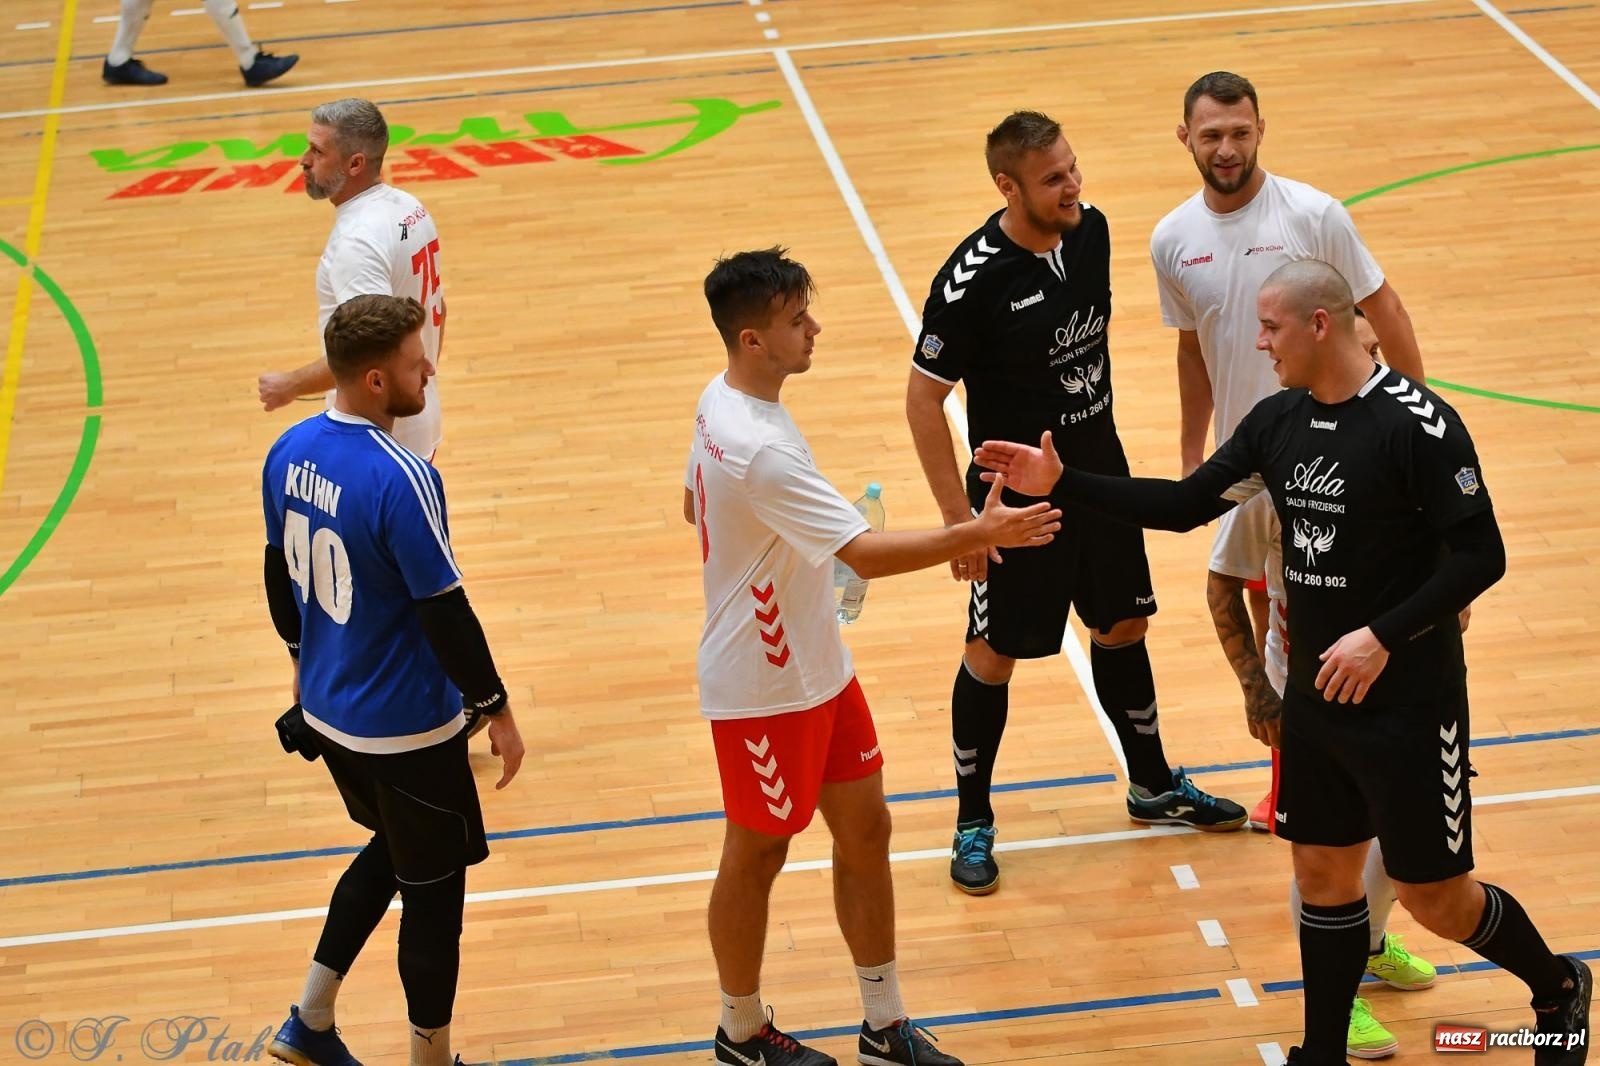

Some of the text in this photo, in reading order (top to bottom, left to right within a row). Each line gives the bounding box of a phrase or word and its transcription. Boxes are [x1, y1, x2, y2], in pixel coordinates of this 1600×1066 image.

[1181, 252, 1214, 268] hummel
[411, 238, 441, 327] 75
[1010, 290, 1045, 311] hummel
[1049, 305, 1105, 355] Ada
[1049, 352, 1075, 367] SALON
[1070, 409, 1087, 424] 514
[1090, 400, 1104, 416] 260
[1310, 417, 1338, 431] hummel
[1285, 456, 1345, 497] Ada
[285, 460, 342, 518] KÜHN
[1286, 497, 1345, 514] SALON FRYZJERSKI
[1289, 569, 1347, 588] 514 260 902
